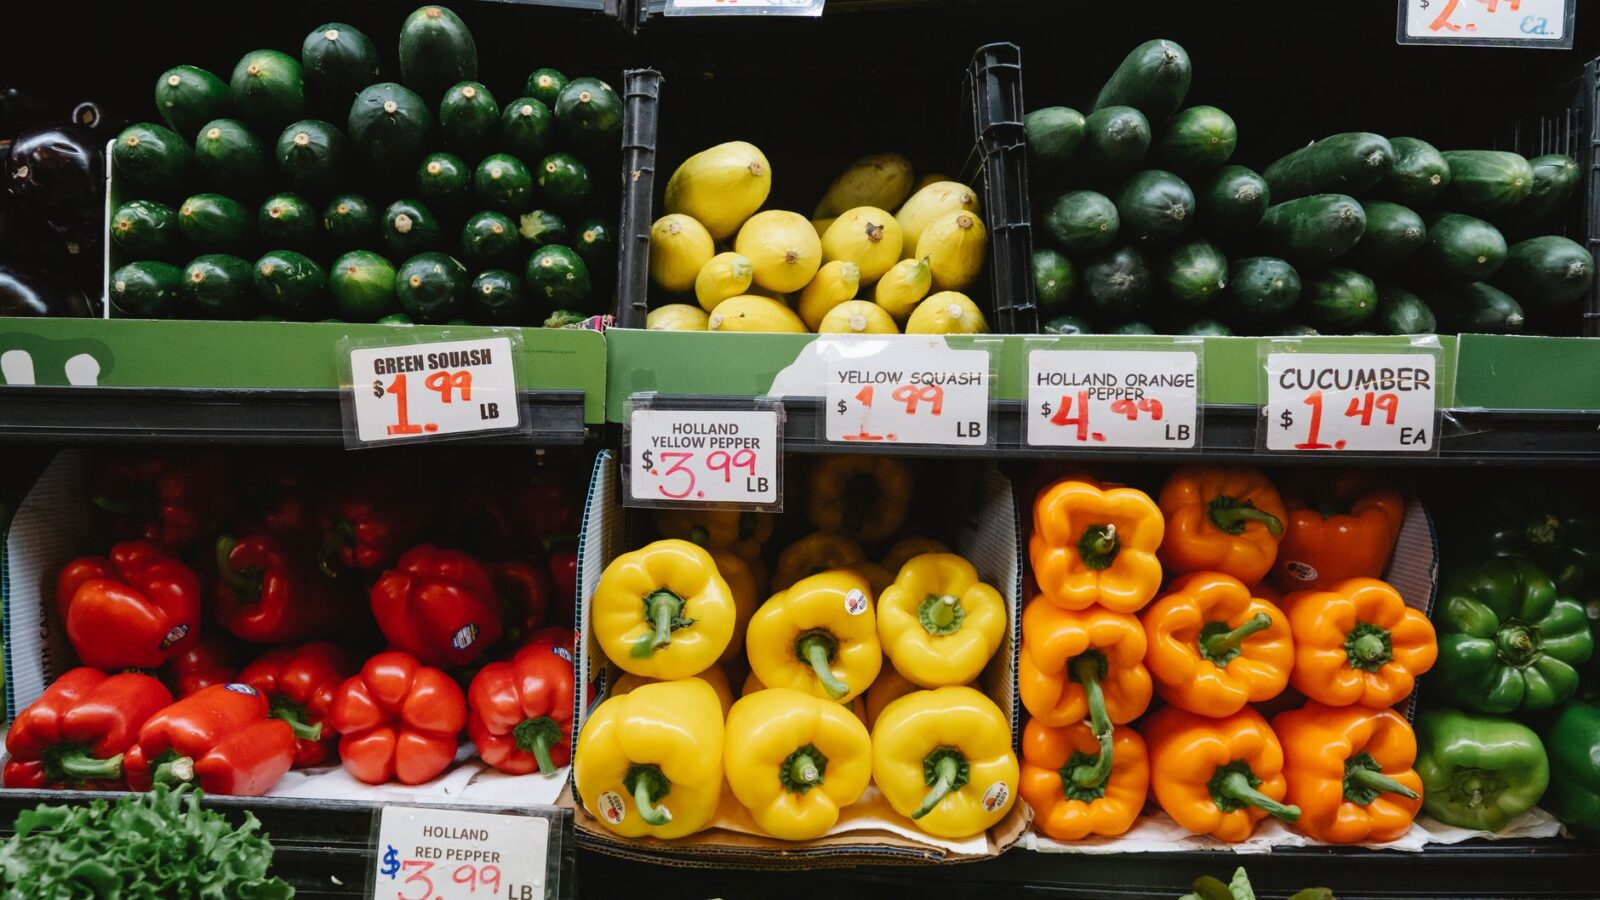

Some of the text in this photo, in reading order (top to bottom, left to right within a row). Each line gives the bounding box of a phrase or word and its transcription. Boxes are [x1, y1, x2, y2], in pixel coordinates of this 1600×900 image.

[374, 354, 425, 375] GREEN
[838, 370, 981, 387] YELLOW SQUASH
[1037, 372, 1194, 388] HOLLAND ORANGE
[1279, 367, 1431, 392] CUCUMBER
[1087, 386, 1145, 401] PEPPER
[480, 403, 500, 420] LB
[672, 423, 739, 435] HOLLAND
[956, 421, 981, 438] LB
[1165, 424, 1190, 441] LB
[1399, 427, 1427, 445] EA
[652, 436, 760, 449] YELLOW PEPPER
[746, 477, 769, 493] LB
[423, 825, 489, 841] HOLLAND
[415, 846, 500, 863] RED PEPPER
[508, 884, 533, 900] LB
